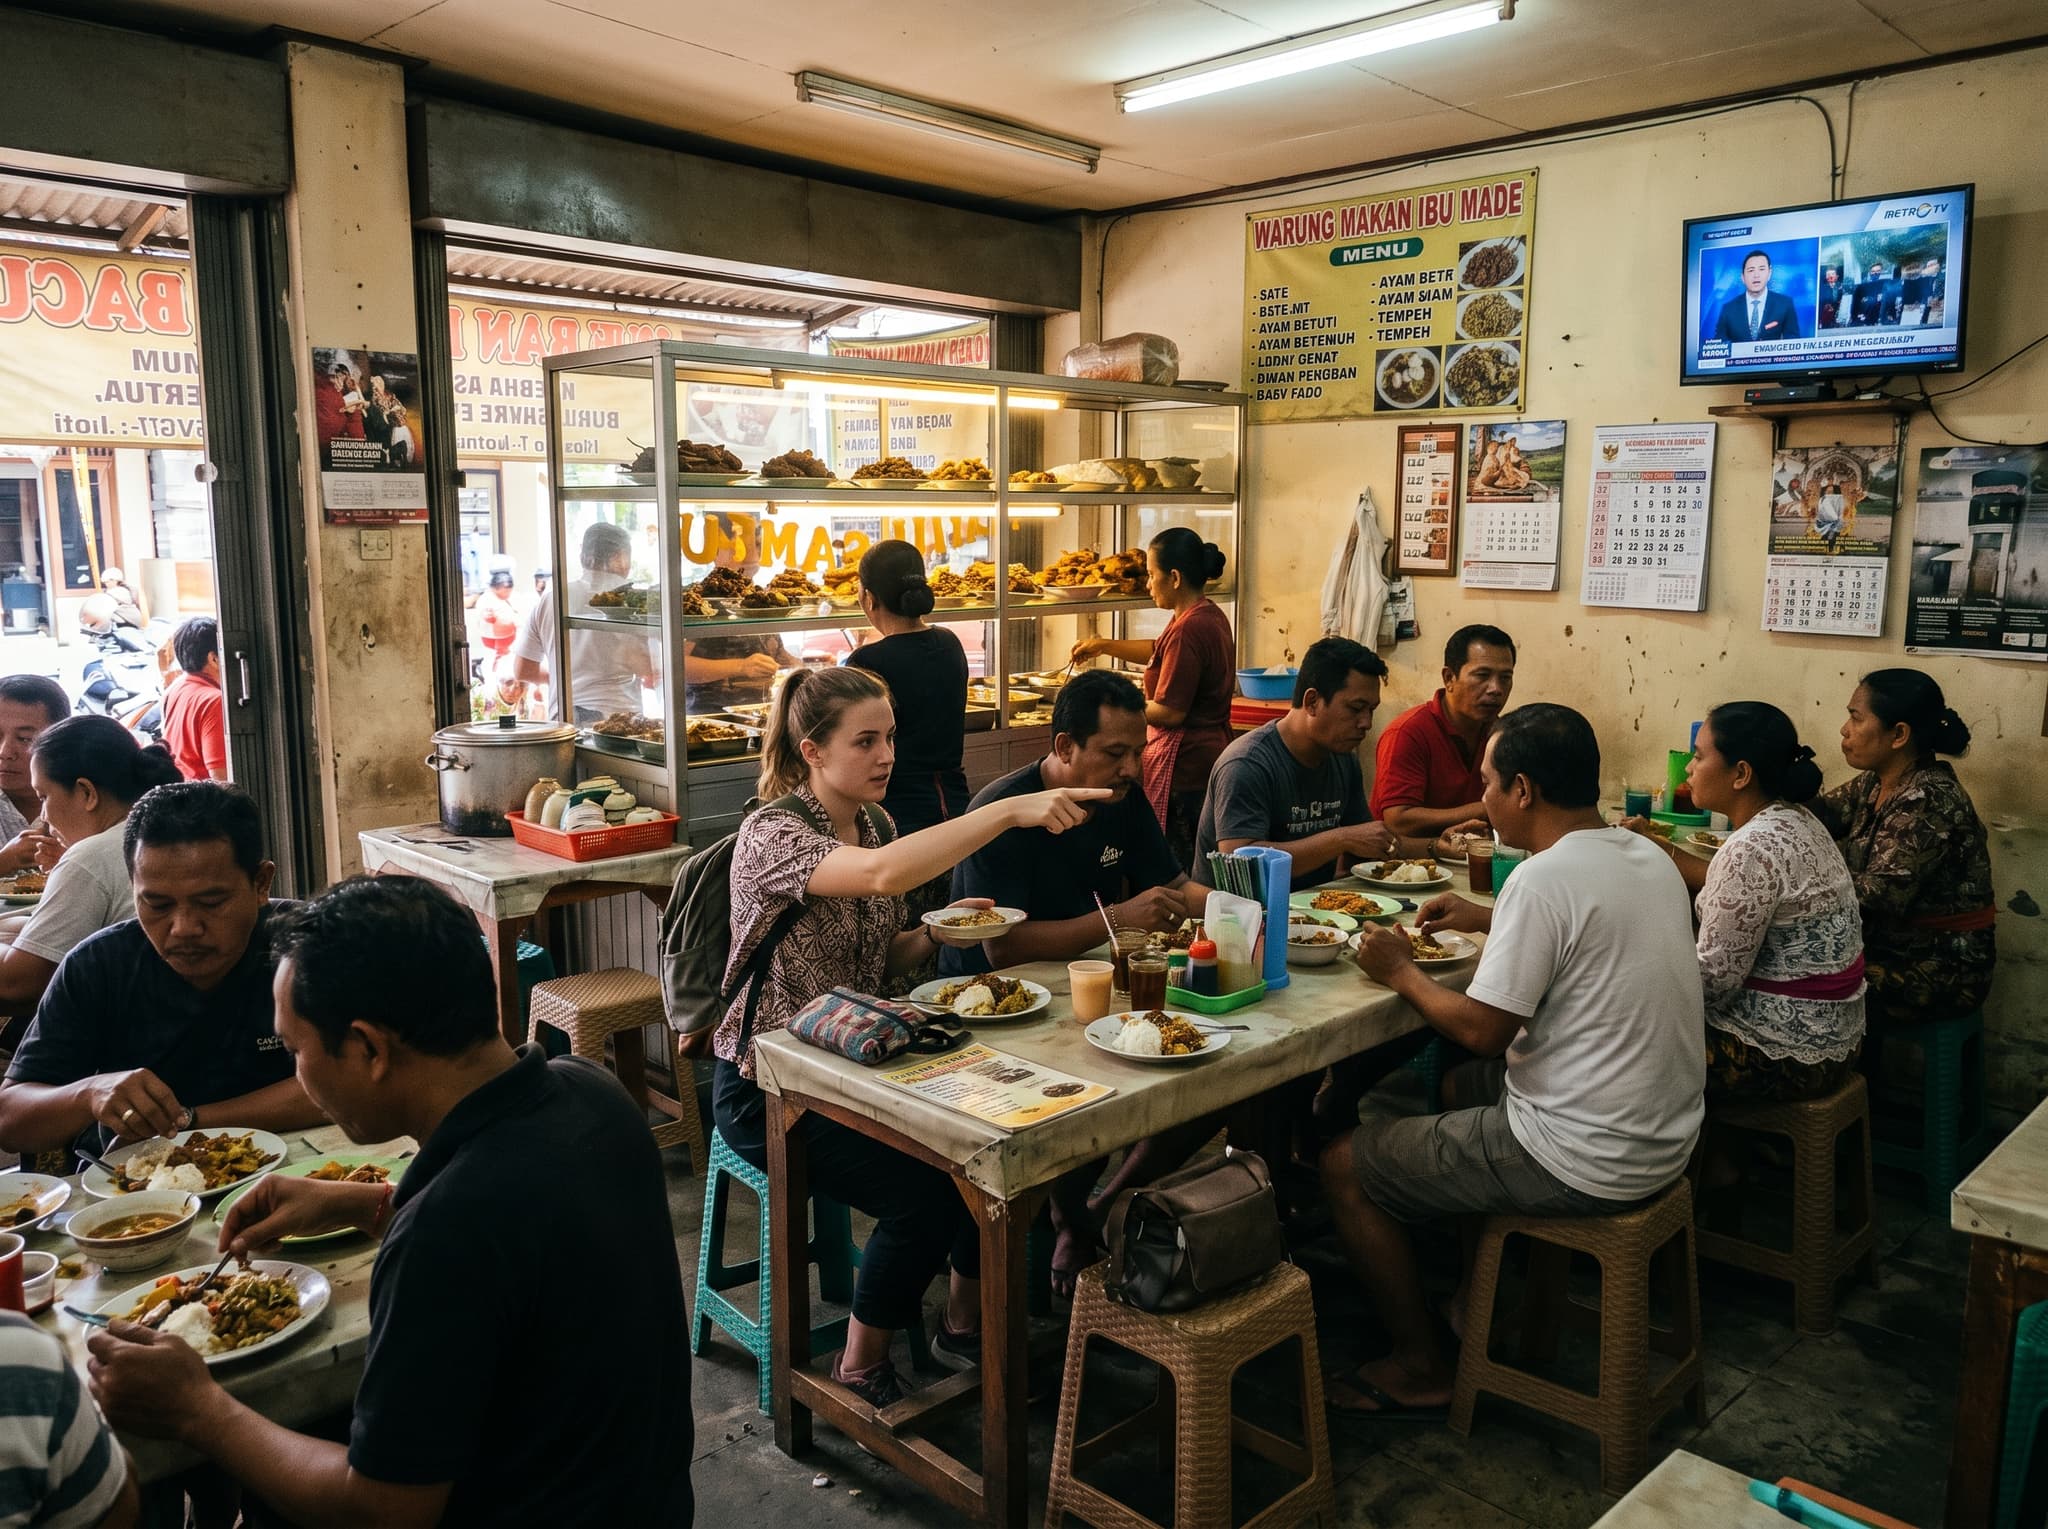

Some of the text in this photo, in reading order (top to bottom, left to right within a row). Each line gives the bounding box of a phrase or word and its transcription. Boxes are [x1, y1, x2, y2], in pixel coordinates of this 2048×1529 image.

[1254, 180, 1524, 249] WARUNG MAKAN IBU MADE
[1343, 242, 1408, 262] MENU
[1379, 273, 1415, 288] AYAM
[1260, 287, 1288, 301] SATE
[1378, 291, 1415, 306] AYAM
[1378, 307, 1432, 324] TEMPEH
[1259, 316, 1337, 334] AYAM BETUTI
[1377, 326, 1430, 341] TEMPEH
[1259, 338, 1290, 351] AYAM
[1291, 386, 1322, 399] FADO
[1649, 486, 1655, 494] 2
[1678, 486, 1687, 494] 24
[1648, 500, 1654, 509] 9
[1692, 500, 1703, 510] 30
[1617, 514, 1622, 522] 7
[1632, 514, 1638, 523] 8
[1675, 515, 1686, 524] 25
[1614, 528, 1623, 536] 14
[1630, 528, 1639, 537] 15
[1613, 542, 1623, 551] 21
[1628, 542, 1639, 551] 22
[1643, 543, 1654, 551] 23
[1658, 543, 1669, 552] 24
[1673, 544, 1684, 552] 25
[1612, 556, 1622, 565] 28
[1627, 556, 1637, 565] 29
[1642, 557, 1652, 565] 30
[1657, 557, 1667, 566] 31
[1849, 601, 1860, 609] 20
[1848, 611, 1858, 619] 27
